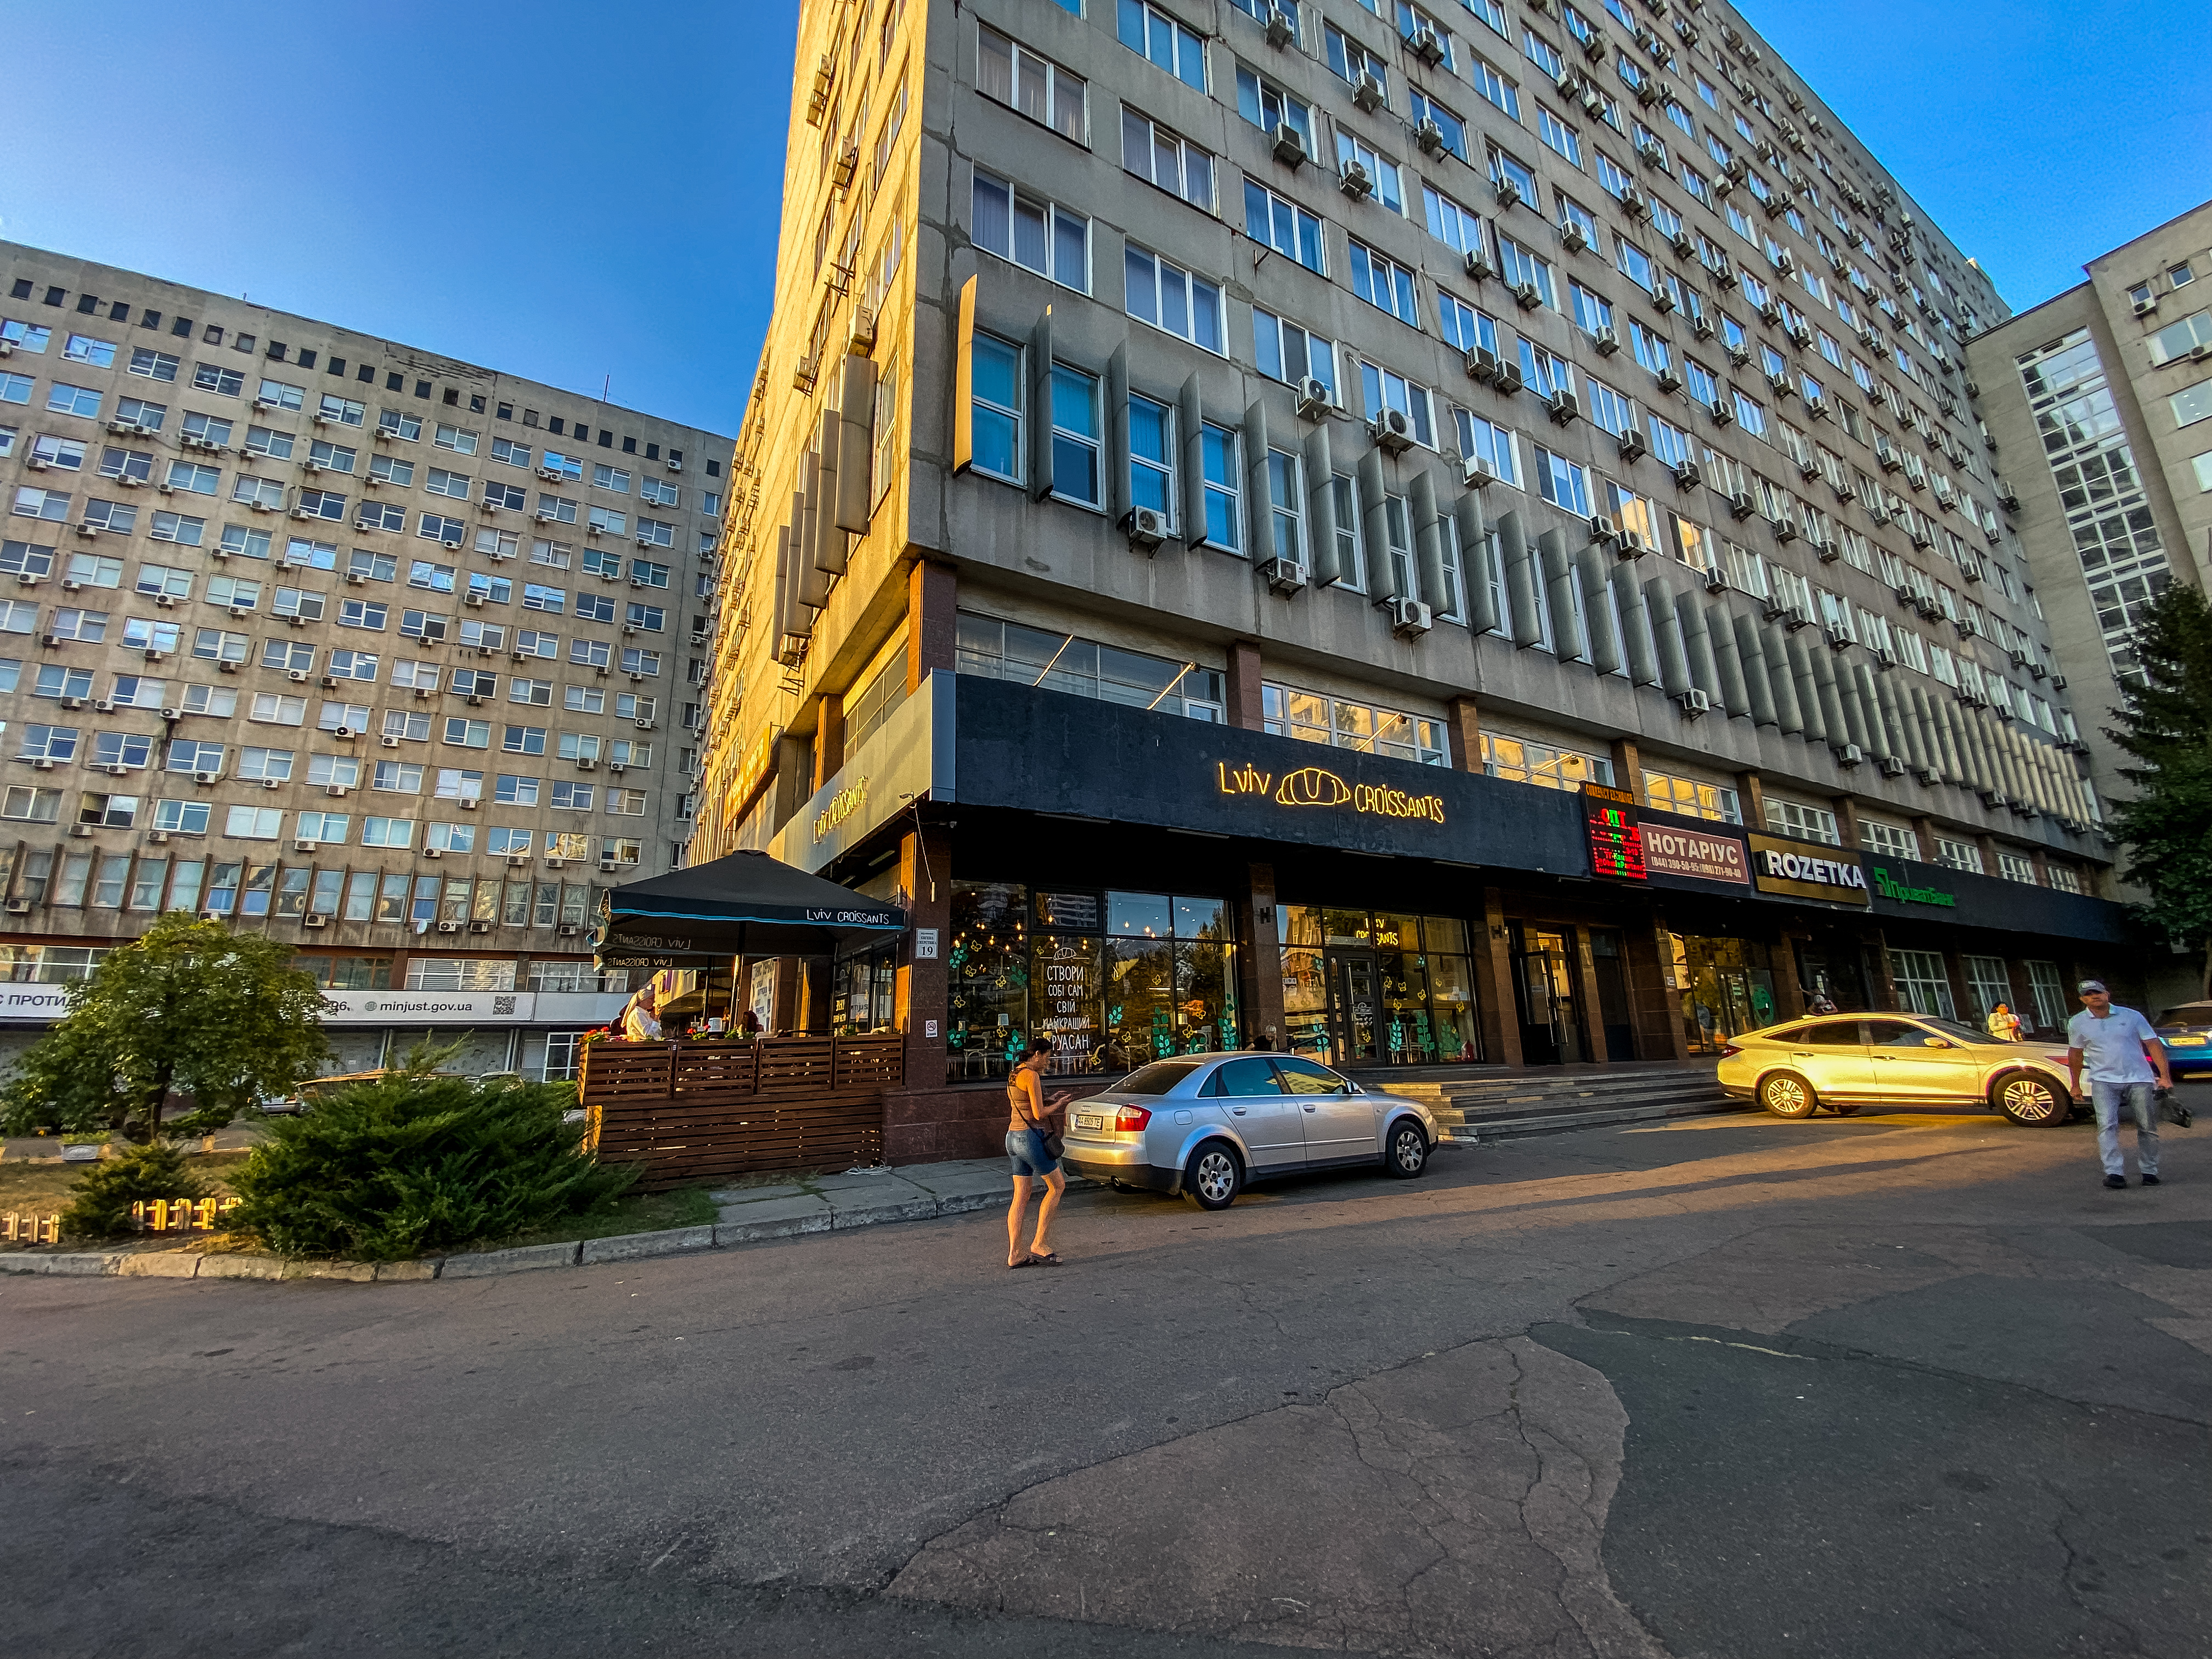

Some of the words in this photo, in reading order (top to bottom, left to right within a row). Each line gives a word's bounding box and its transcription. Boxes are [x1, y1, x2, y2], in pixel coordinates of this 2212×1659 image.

[1647, 832, 1738, 865] НОТАРІУС
[1765, 850, 1866, 889] ROZETKA
[922, 946, 933, 956] 19
[1047, 966, 1084, 981] СТВОРИ
[1048, 984, 1064, 996] СОБІ
[1068, 984, 1083, 996] САМ
[380, 1001, 472, 1013] minjust.gov.ua
[1057, 999, 1076, 1013] СВІЙ
[1042, 1014, 1090, 1030] НАЙКРАЩИЙ
[1052, 1034, 1089, 1051] РУАСАН
